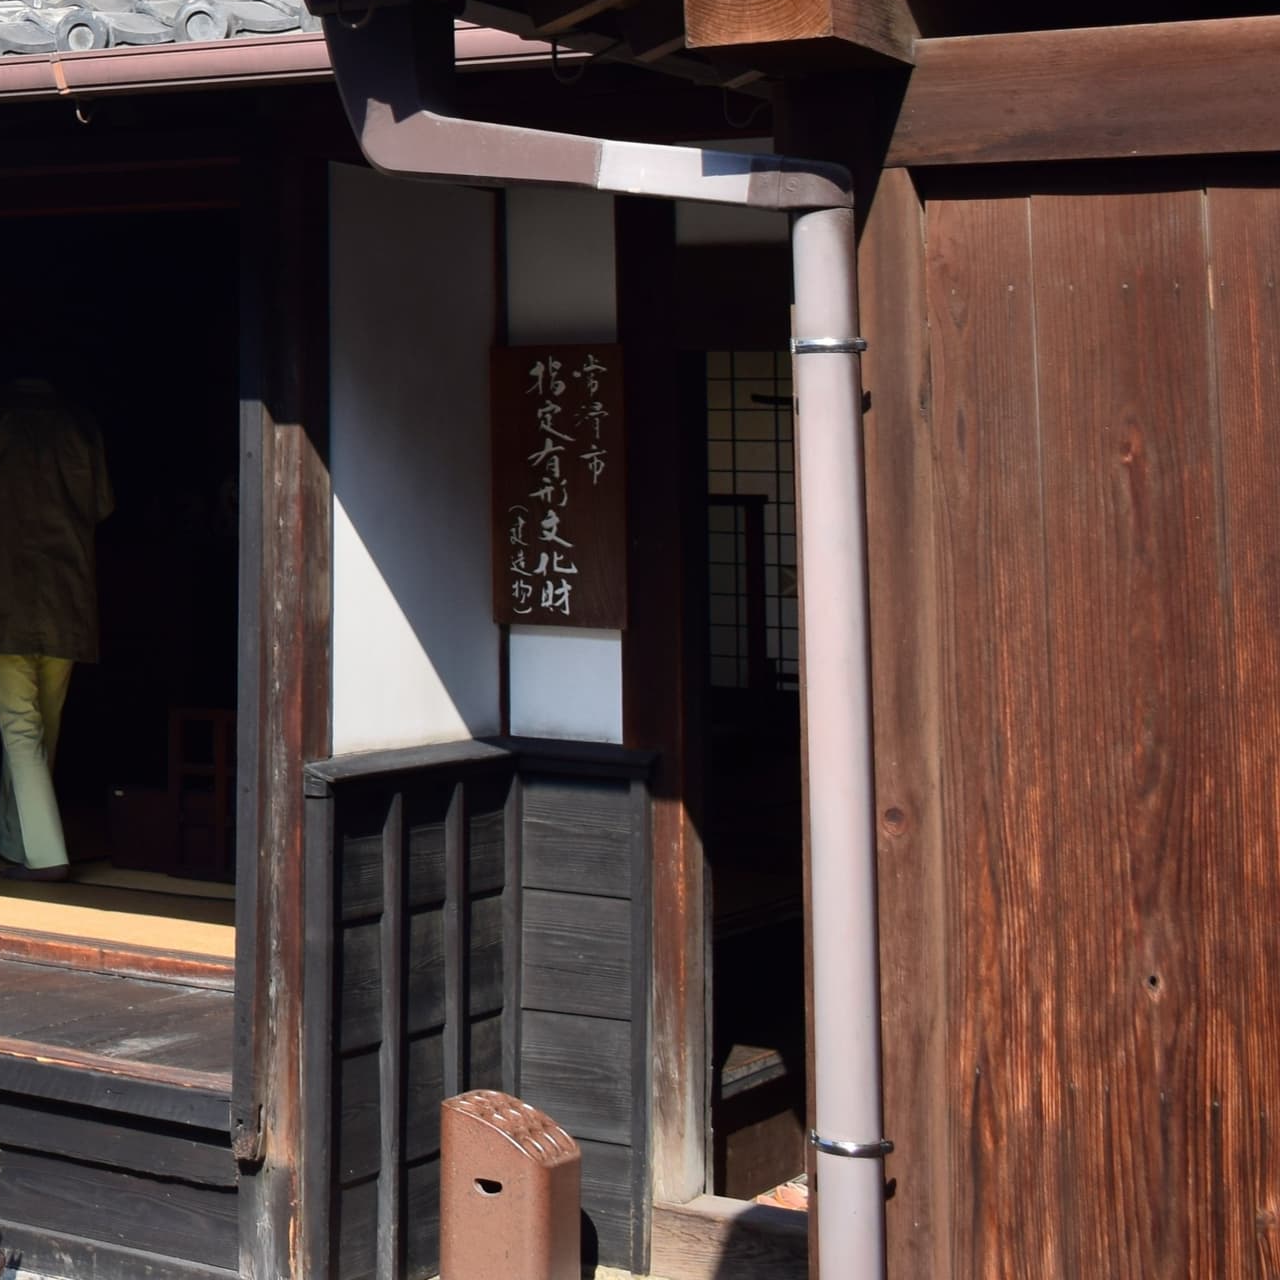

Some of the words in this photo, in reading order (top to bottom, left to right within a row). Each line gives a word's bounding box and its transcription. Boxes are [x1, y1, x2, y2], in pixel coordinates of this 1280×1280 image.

[526, 356, 579, 616] 指定有形文化財
[572, 354, 609, 485] 常滑市
